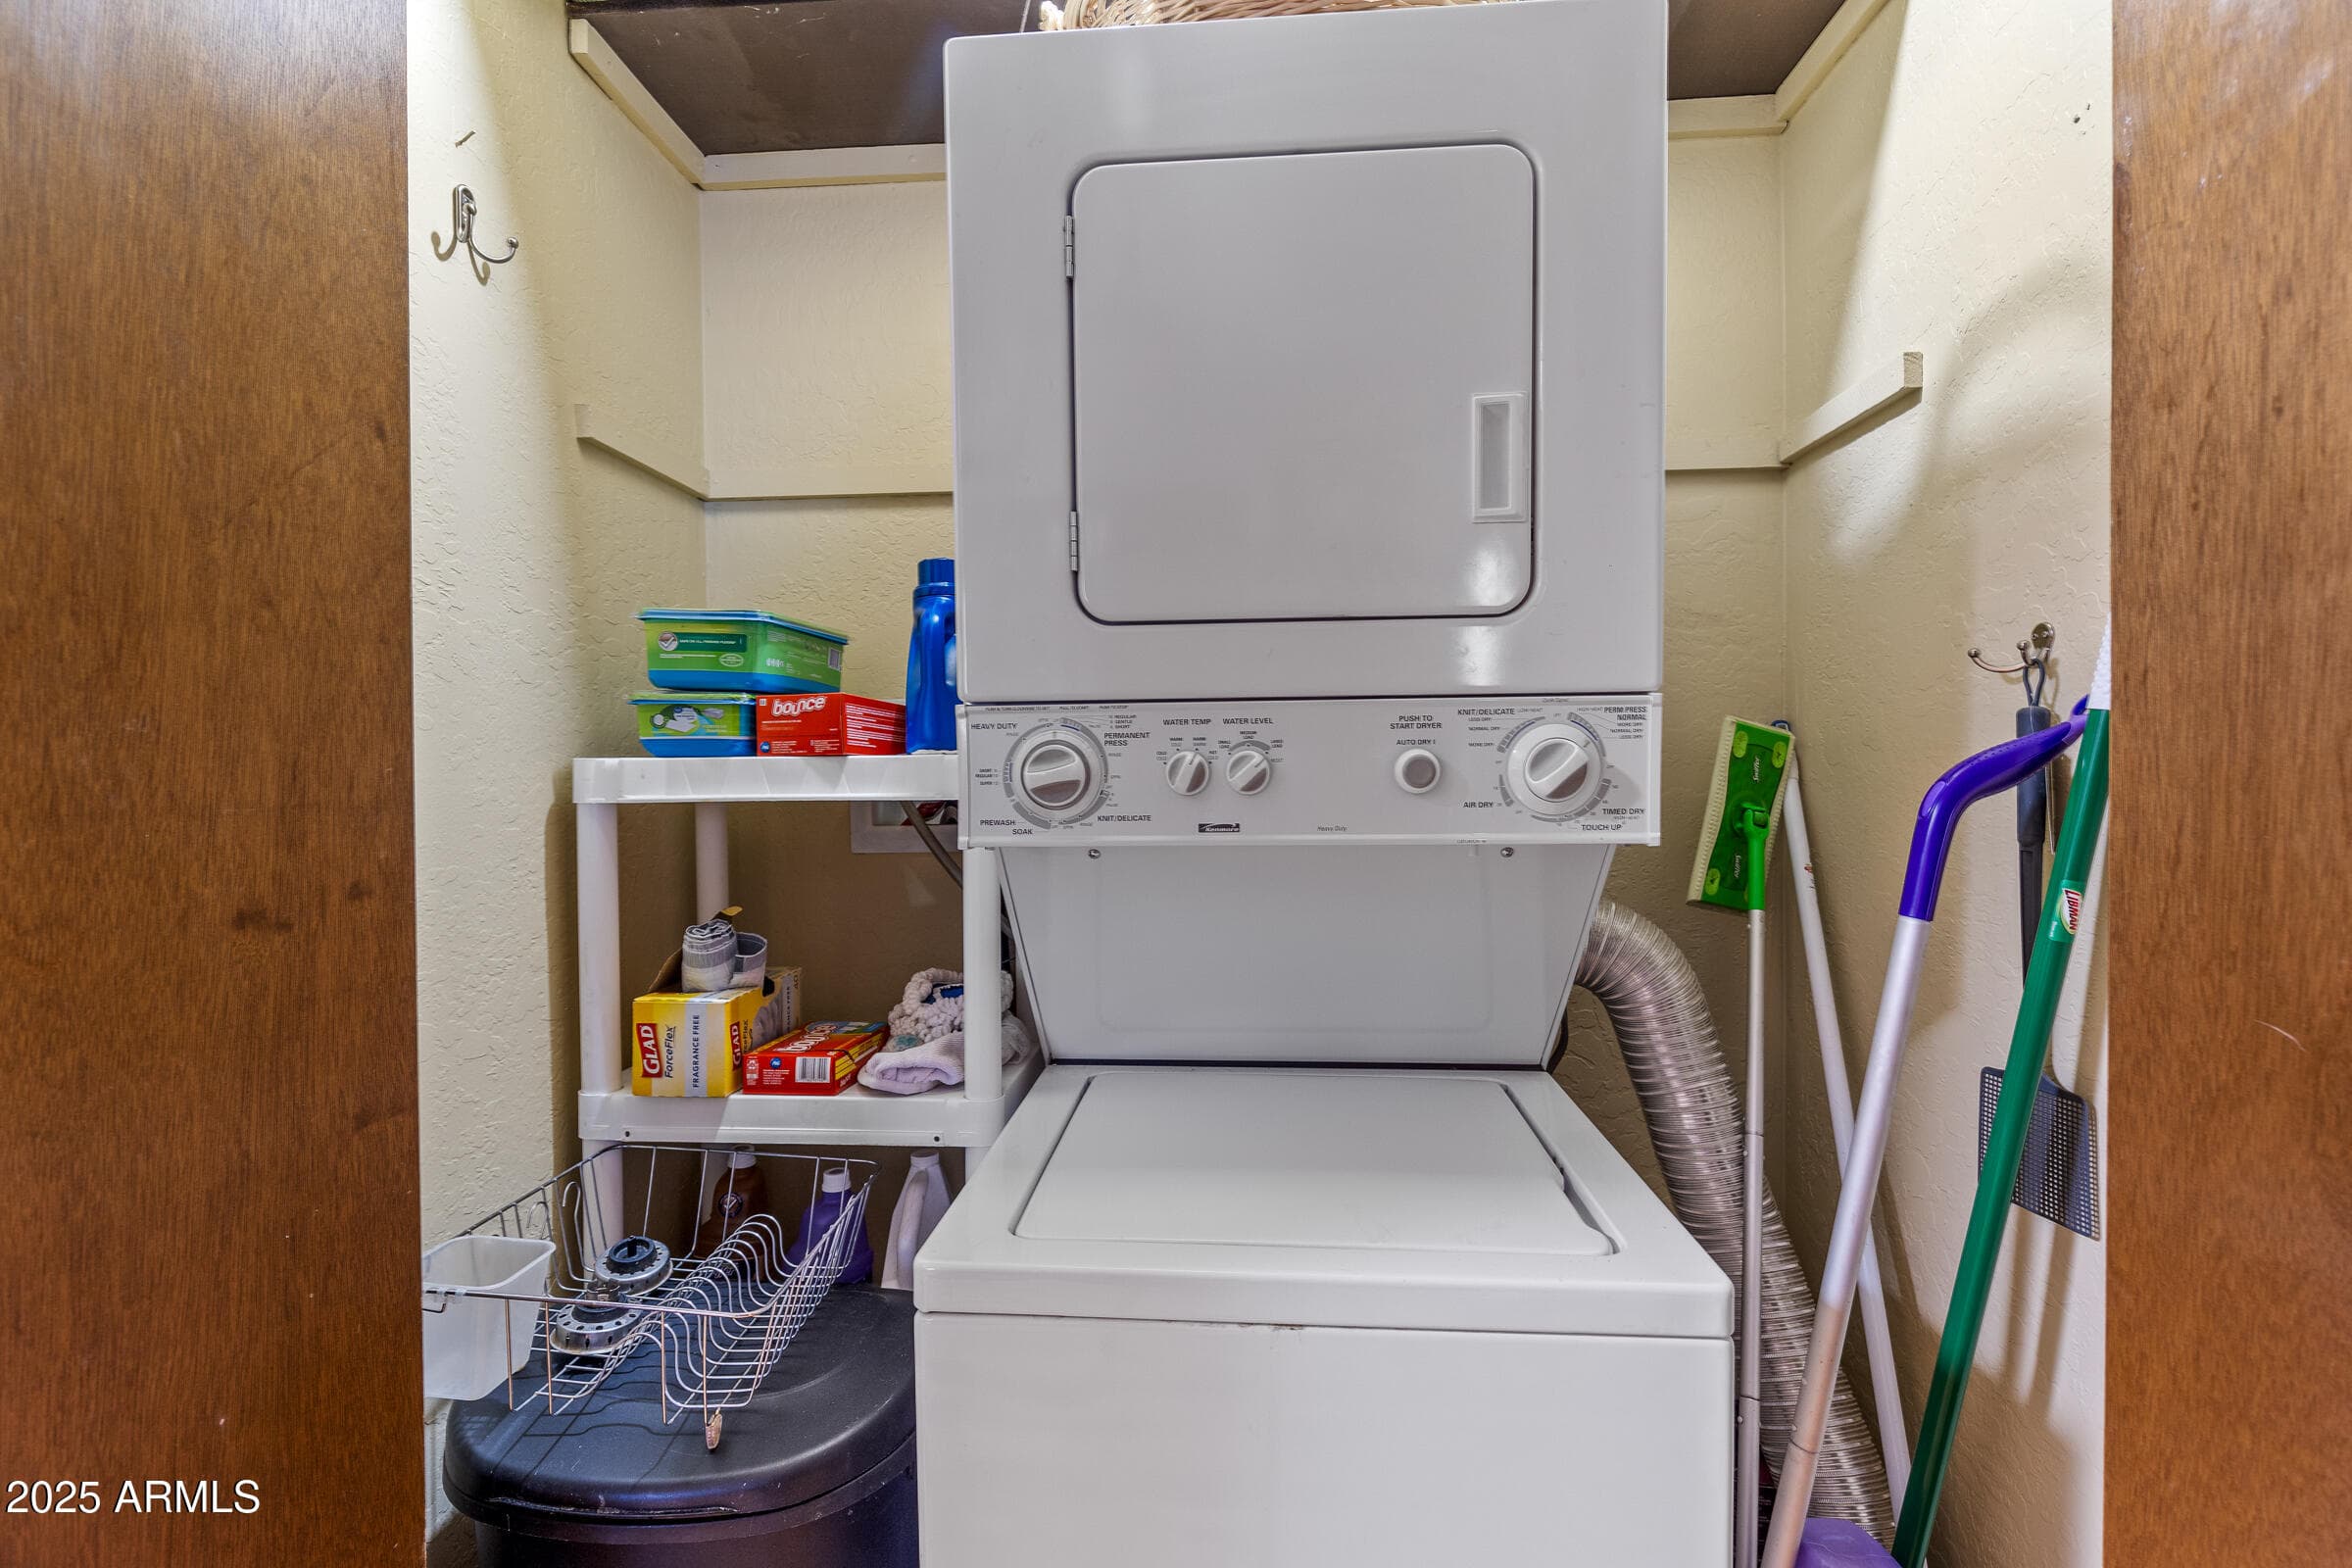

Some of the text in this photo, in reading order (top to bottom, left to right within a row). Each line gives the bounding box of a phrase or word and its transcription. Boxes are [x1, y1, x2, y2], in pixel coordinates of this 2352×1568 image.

[771, 696, 826, 715] bounce
[2064, 889, 2081, 930] LIBMAN
[640, 1025, 660, 1075] GLAD
[664, 1026, 675, 1078] ForceFlex
[731, 1025, 741, 1065] GLAD
